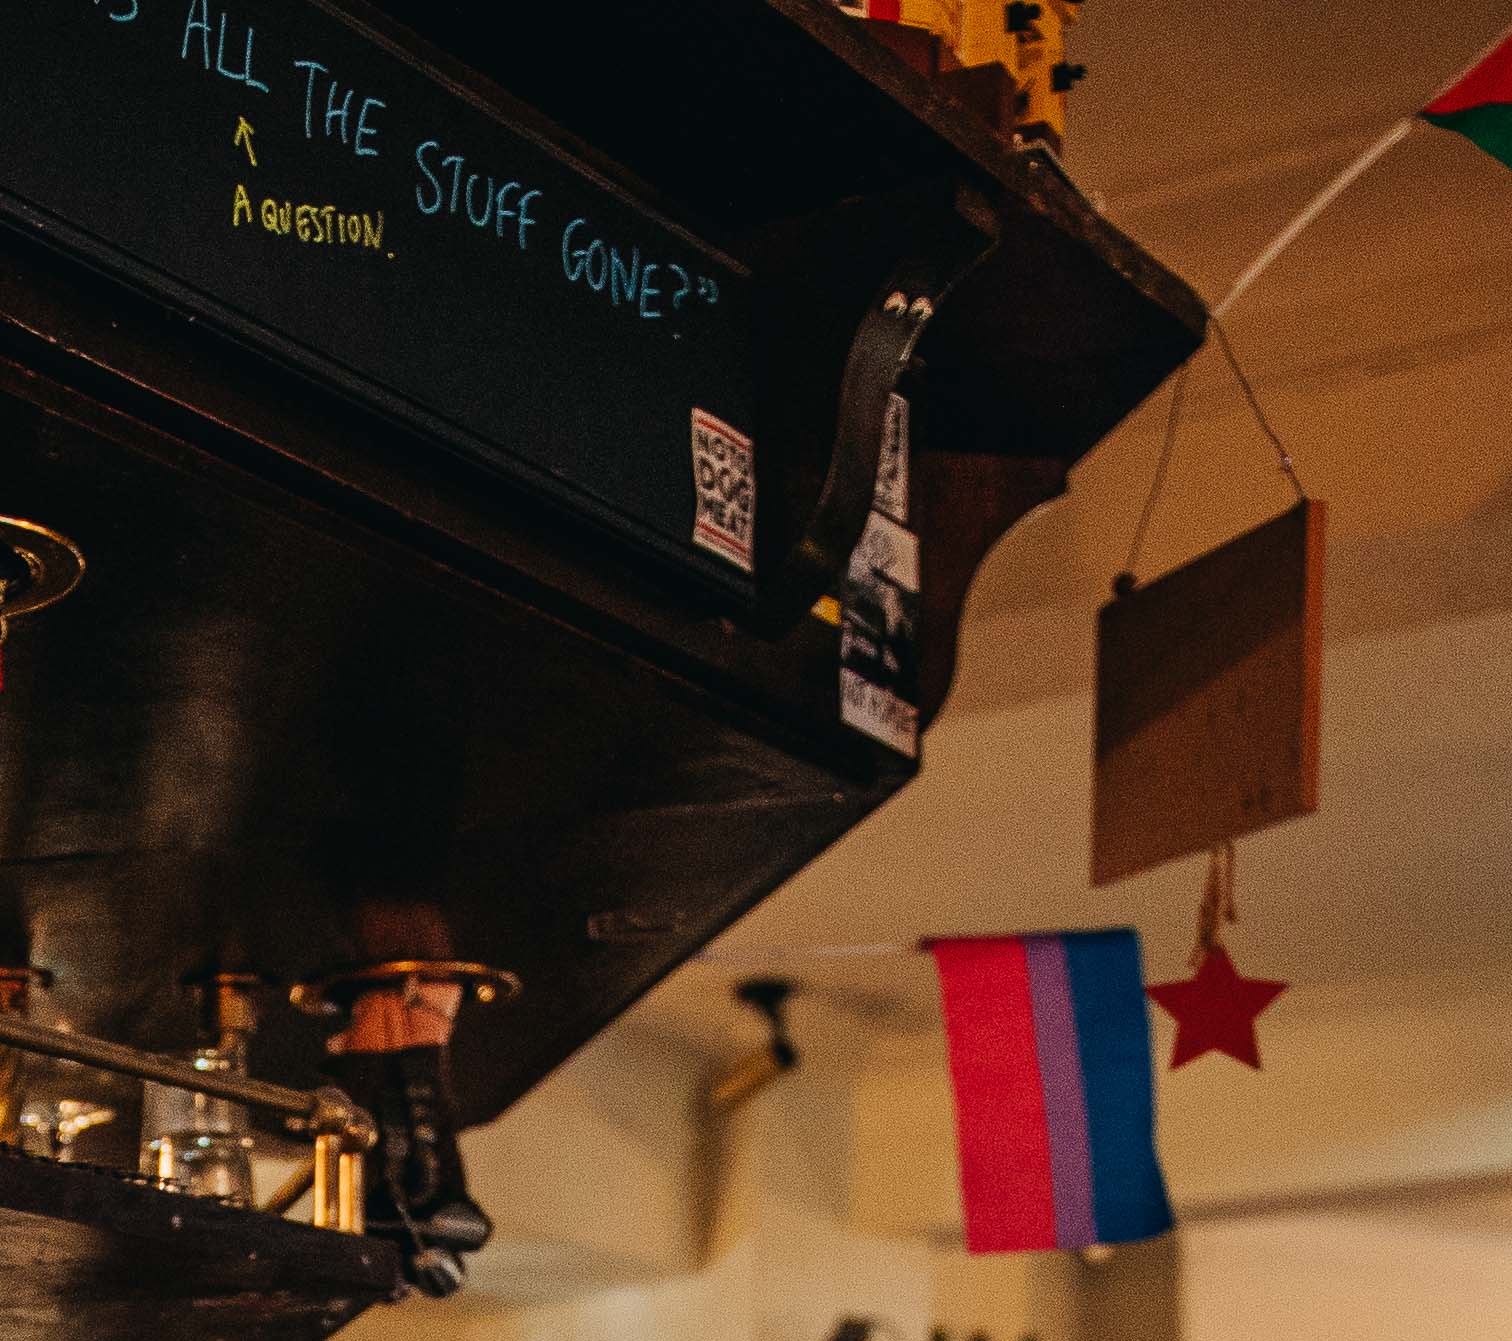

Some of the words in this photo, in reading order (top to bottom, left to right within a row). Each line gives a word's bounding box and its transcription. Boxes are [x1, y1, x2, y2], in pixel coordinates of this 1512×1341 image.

[181, 0, 269, 93] ALL
[294, 60, 386, 157] THE
[415, 140, 541, 251] STUFF
[233, 187, 252, 227] A
